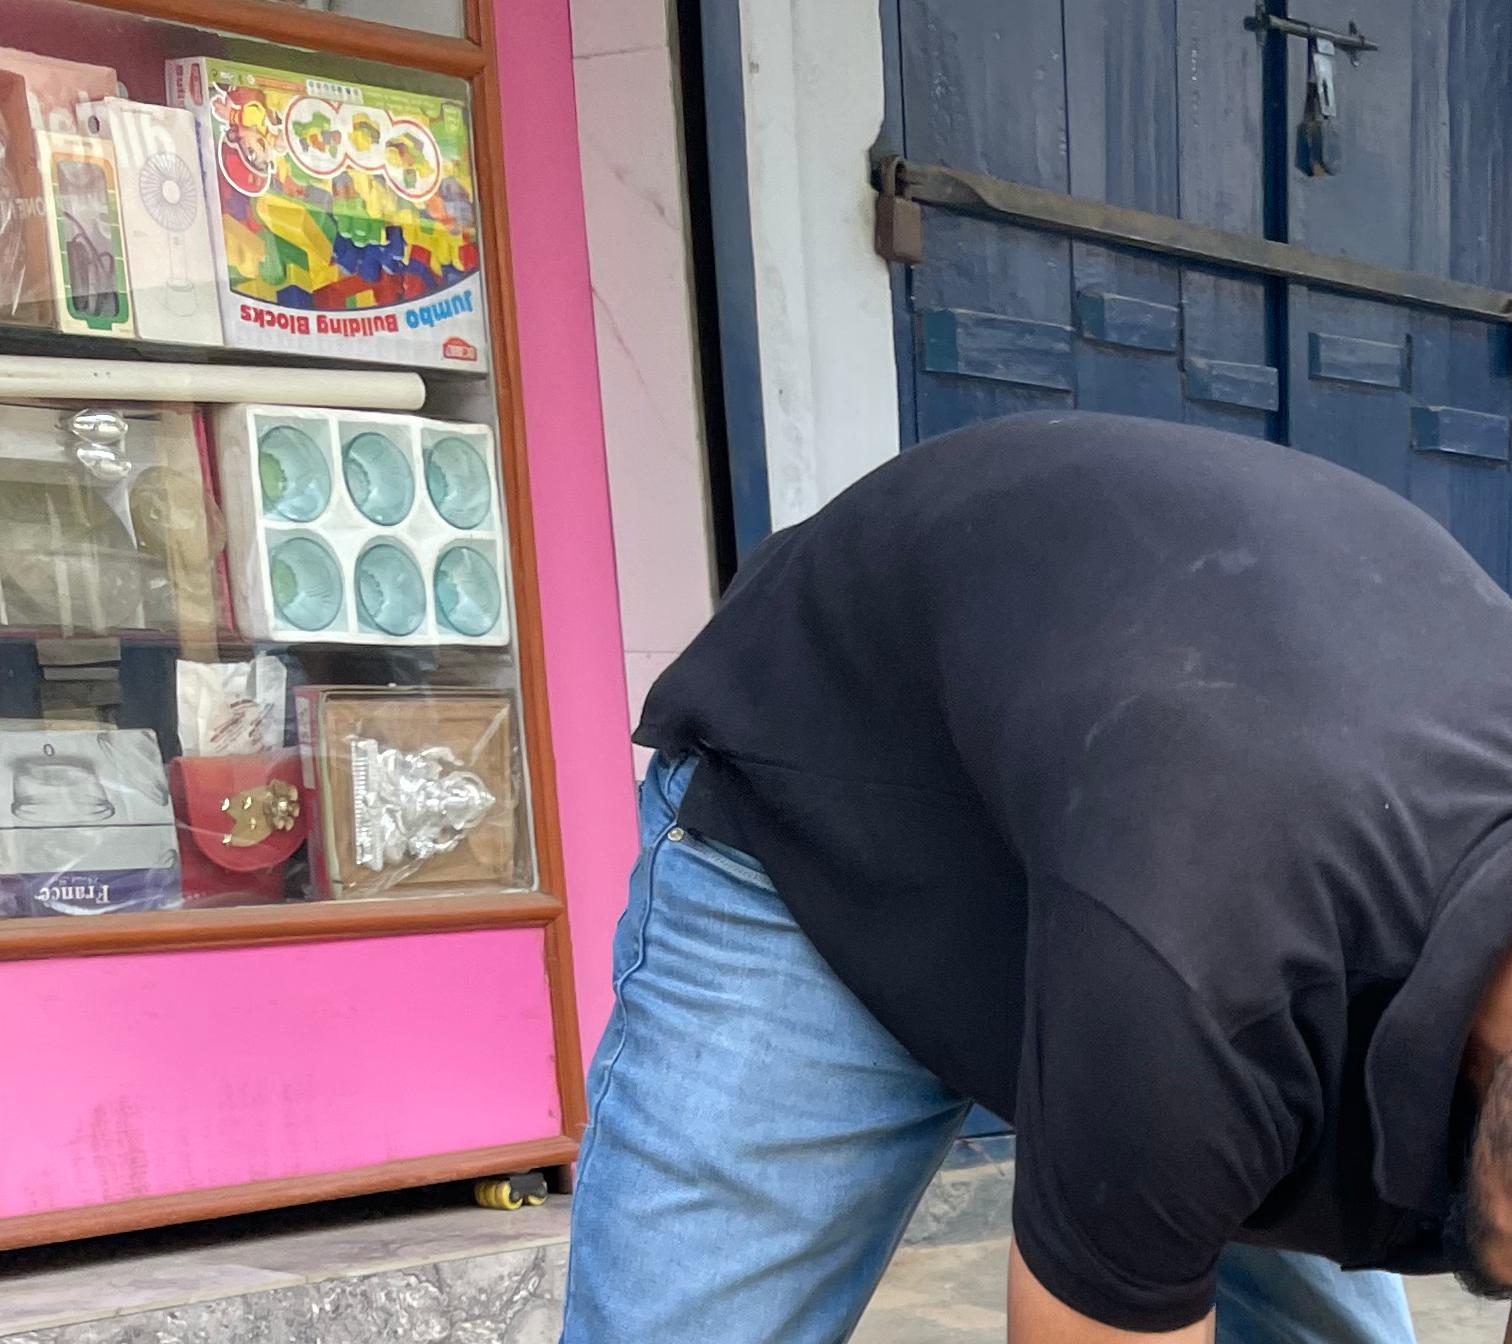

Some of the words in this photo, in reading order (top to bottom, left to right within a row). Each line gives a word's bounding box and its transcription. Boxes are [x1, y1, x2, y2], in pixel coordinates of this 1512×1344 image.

[240, 304, 311, 335] Blocks
[405, 289, 474, 329] Jumbo
[316, 313, 399, 337] Building
[39, 885, 110, 904] France
